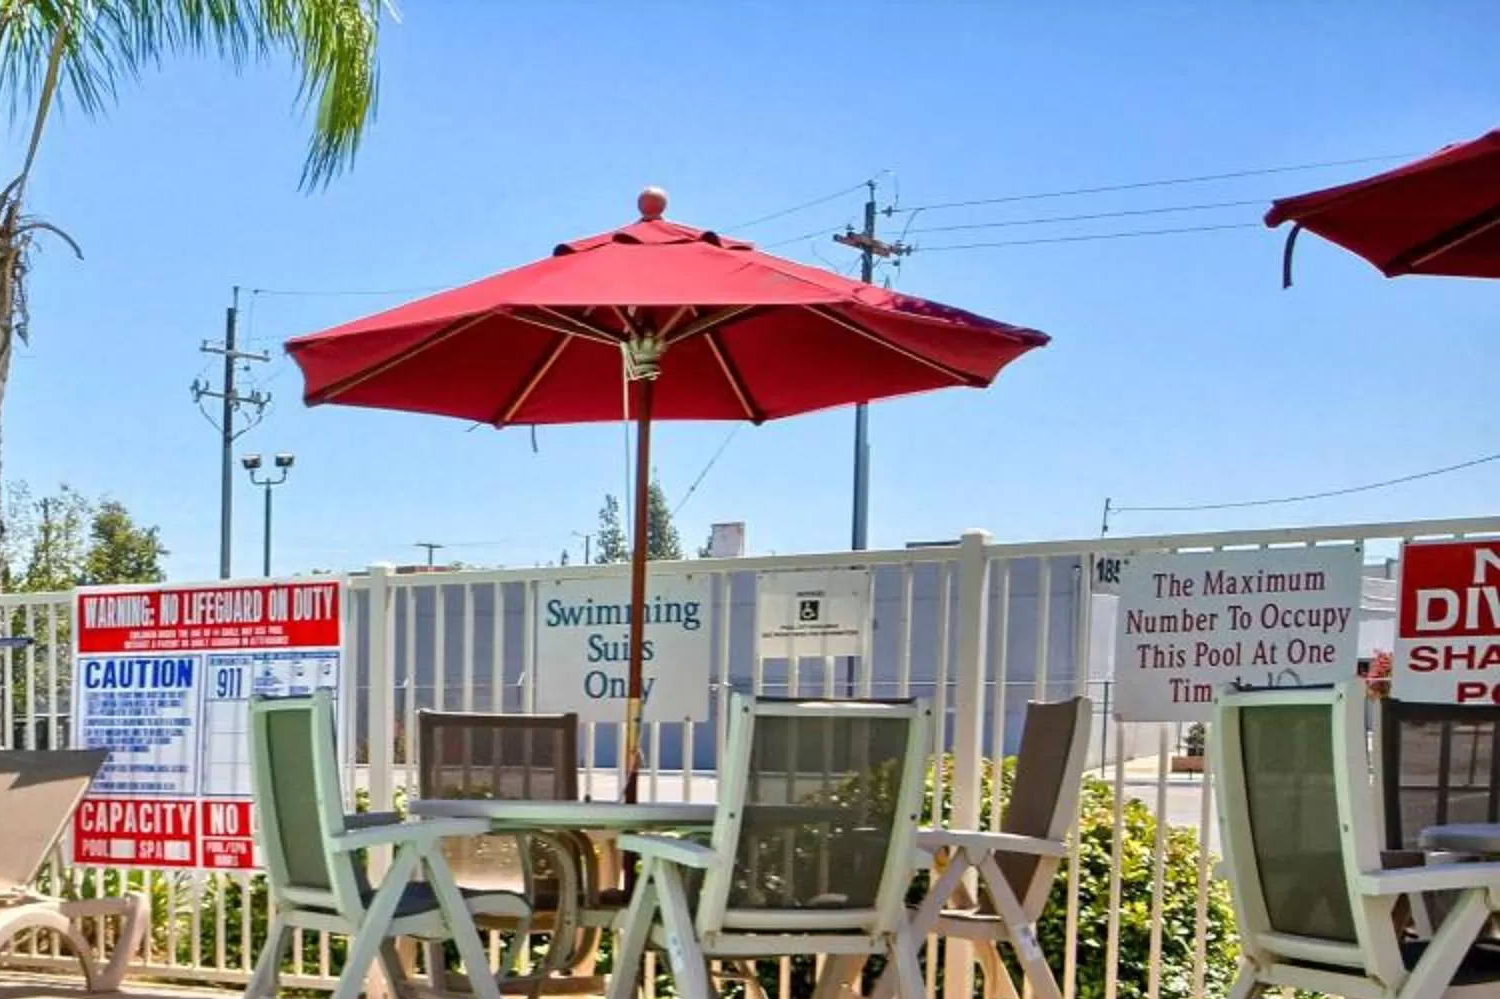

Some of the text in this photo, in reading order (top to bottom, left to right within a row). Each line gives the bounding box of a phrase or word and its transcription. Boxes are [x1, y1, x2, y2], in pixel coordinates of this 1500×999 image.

[1152, 569, 1326, 599] The Maximum
[84, 585, 335, 629] WARNING: NO LIFEGUARD ON DUTY
[1124, 603, 1353, 634] Number To Occupy
[587, 633, 655, 663] Suis
[1136, 639, 1337, 670] This Pool At One
[84, 659, 194, 689] CAUTION
[216, 667, 242, 697] 911
[584, 670, 657, 705] Ony
[1169, 677, 1219, 704] Tim
[1457, 682, 1500, 705] P
[80, 801, 193, 835] CAPACITY
[210, 803, 239, 834] NO
